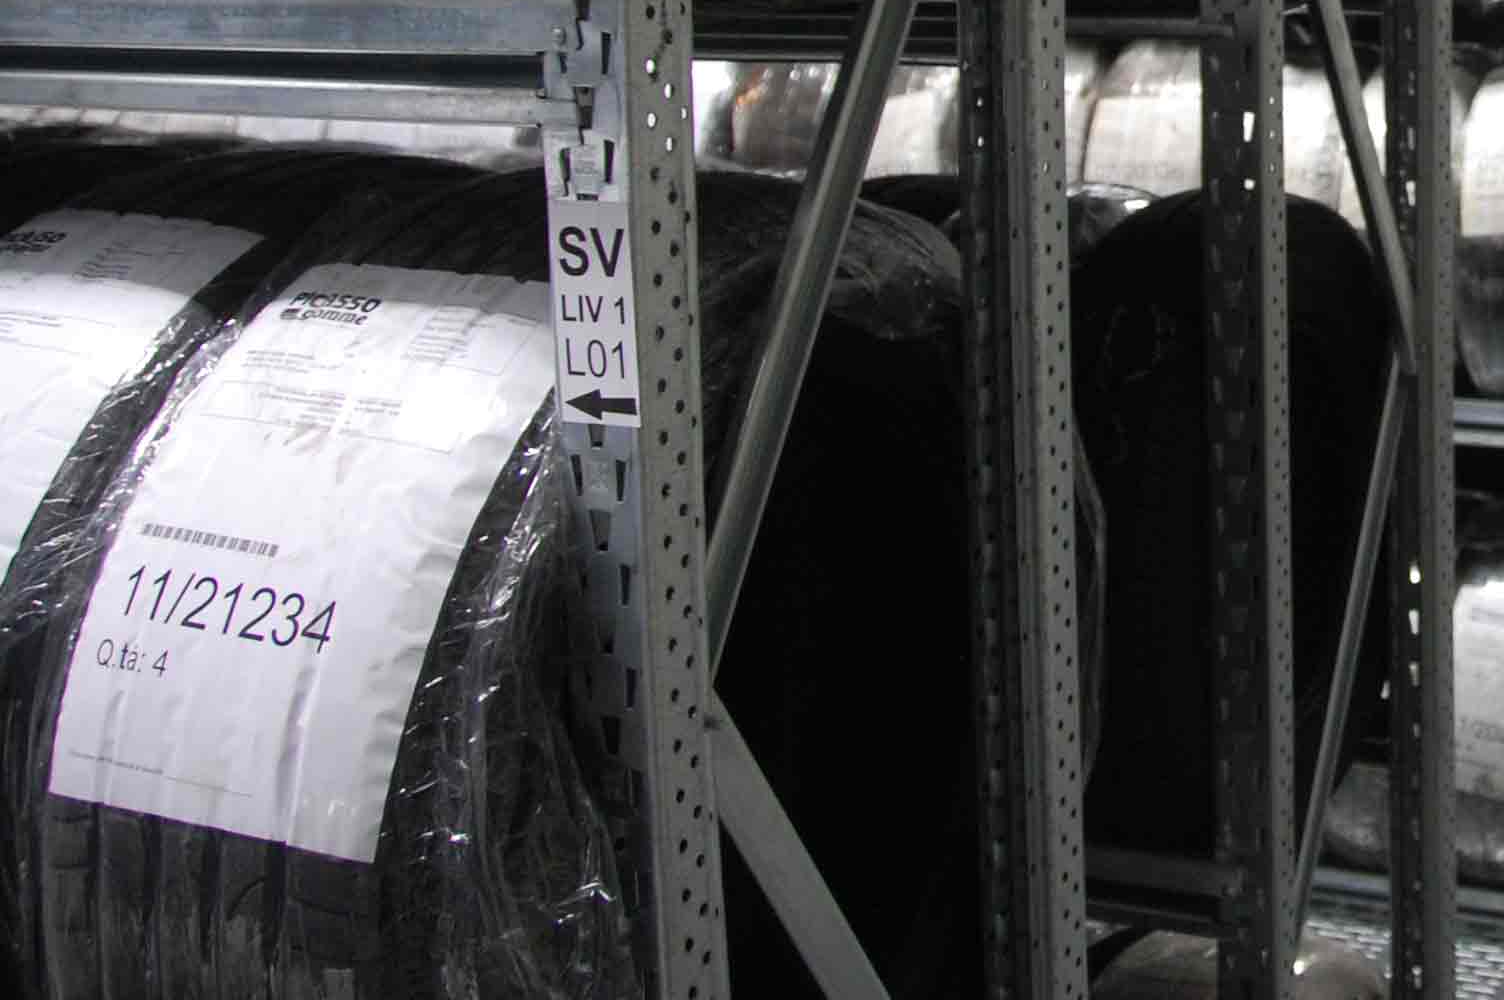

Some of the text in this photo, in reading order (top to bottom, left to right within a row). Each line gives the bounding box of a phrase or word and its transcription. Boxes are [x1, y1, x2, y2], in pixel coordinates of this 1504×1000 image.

[559, 226, 625, 278] SV
[561, 294, 626, 325] LIV 1
[124, 564, 337, 655] 11/21234
[151, 649, 169, 677] 4
